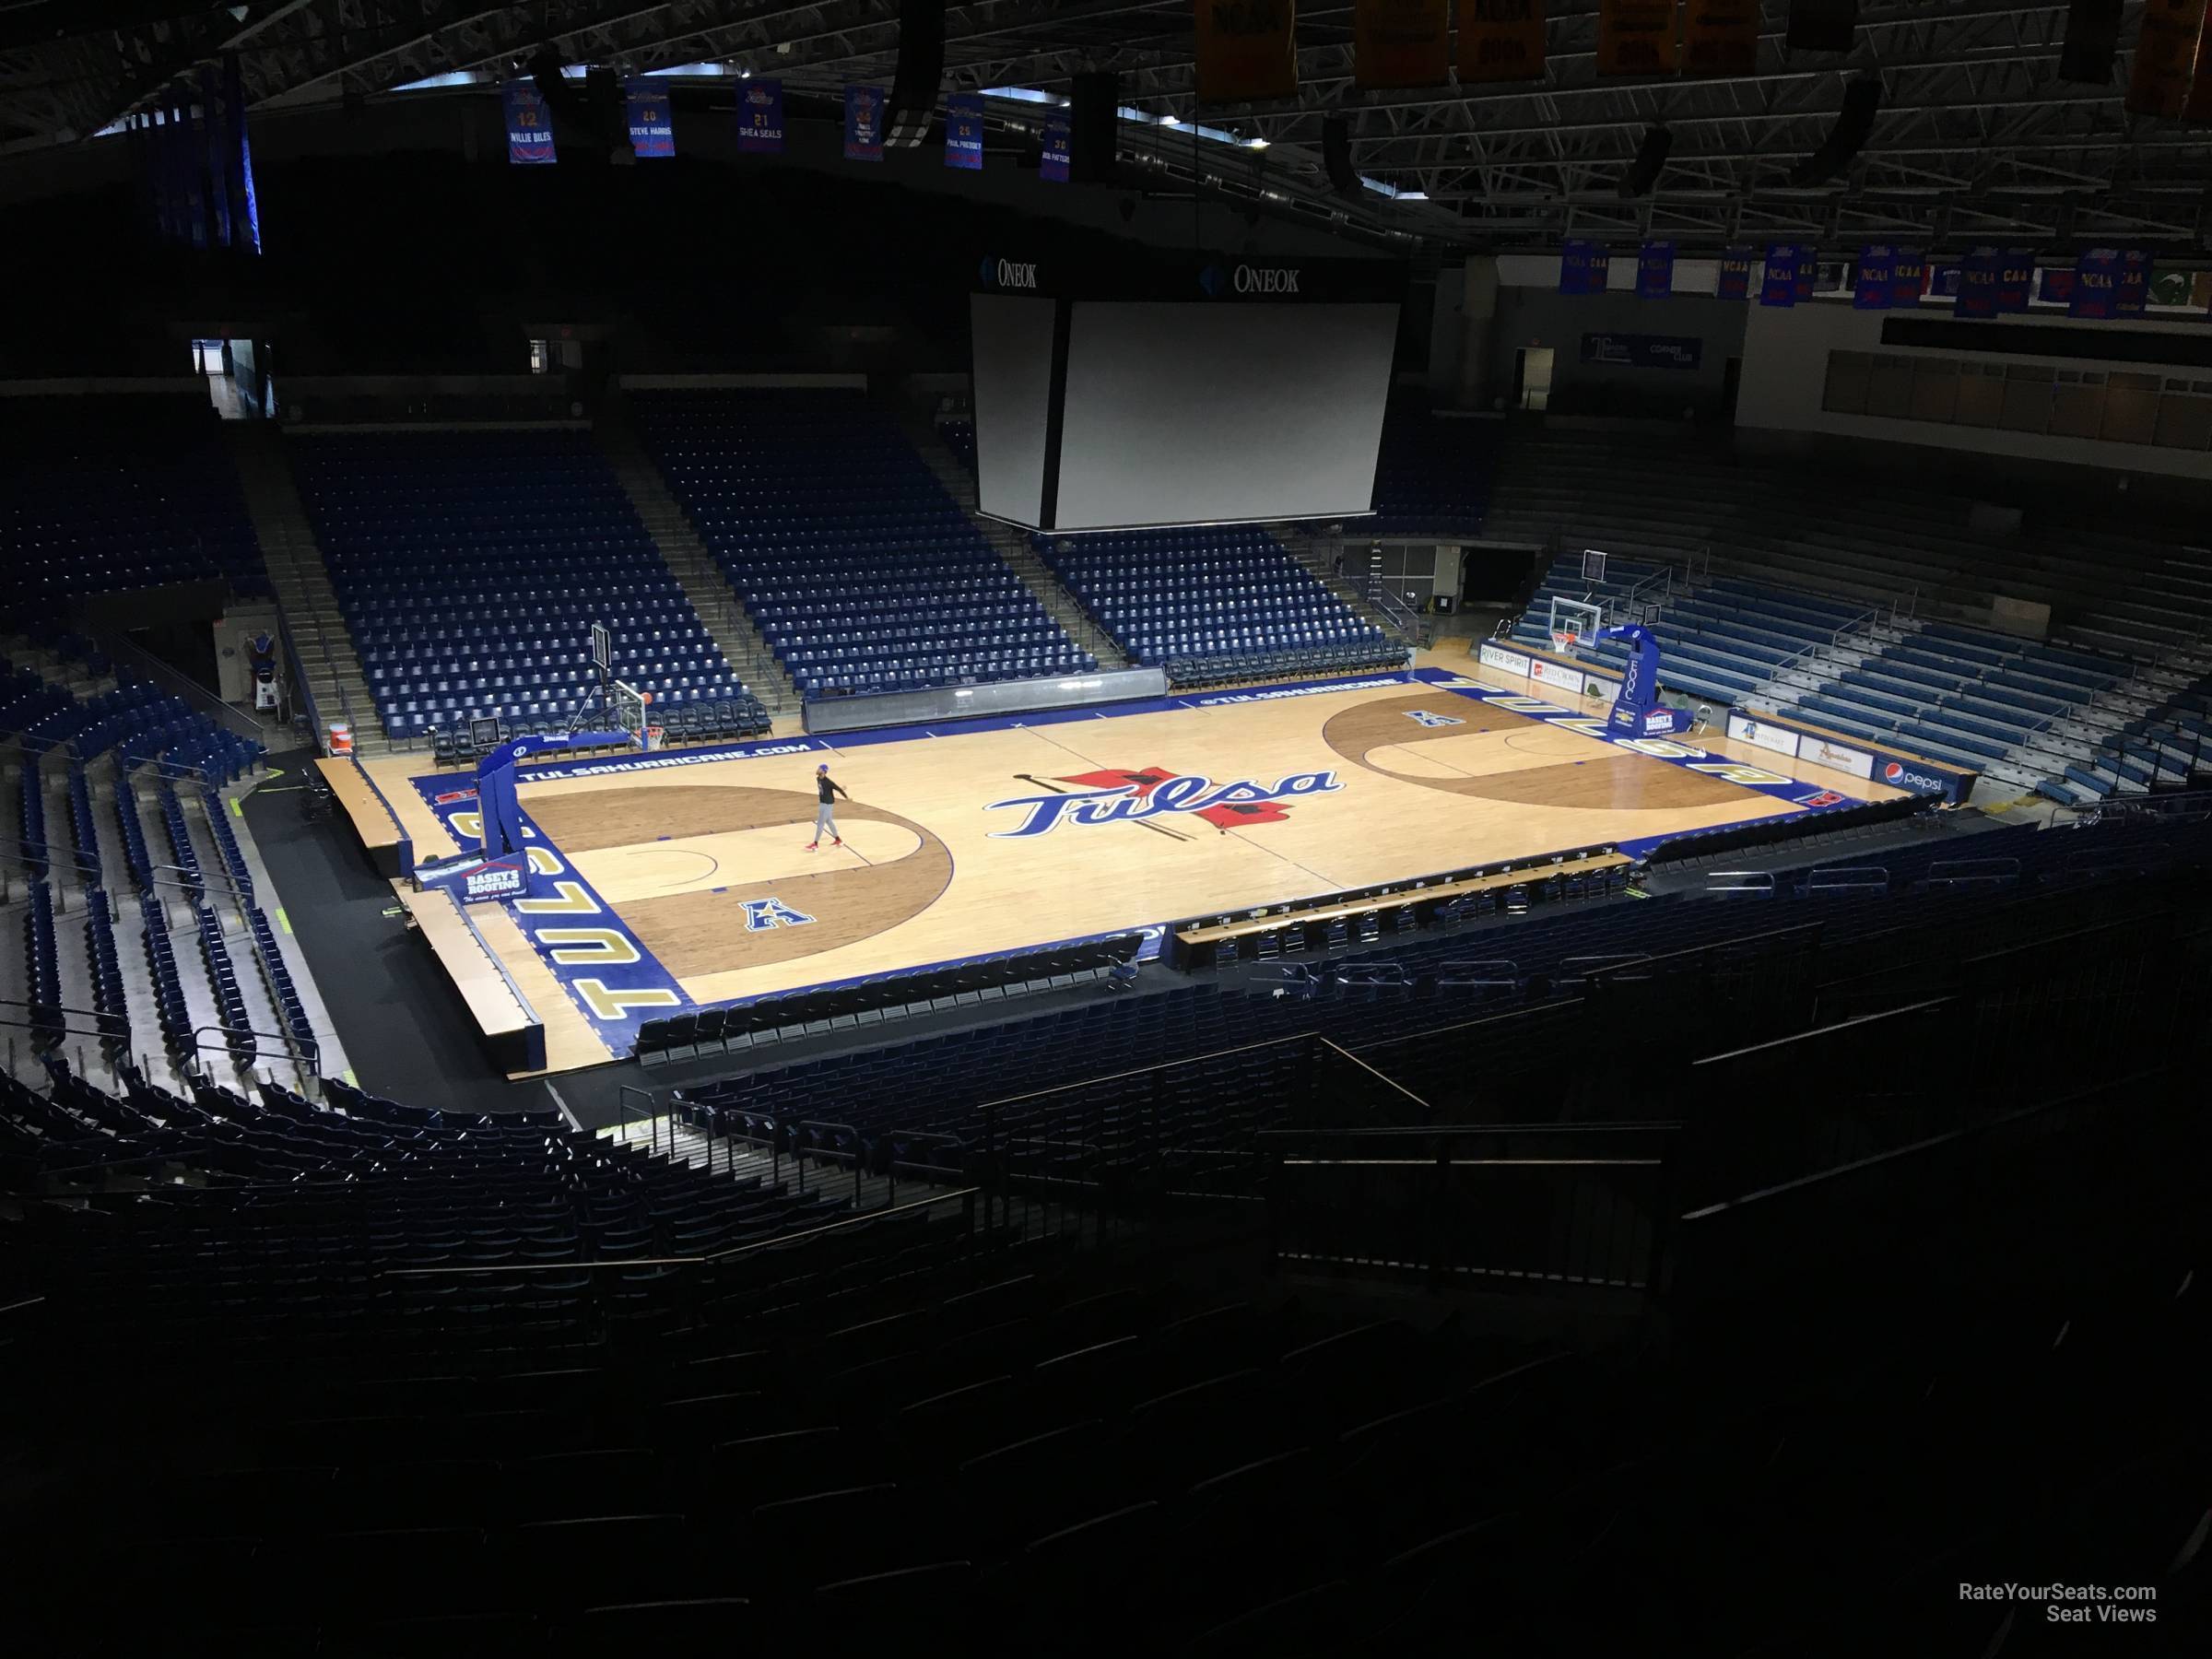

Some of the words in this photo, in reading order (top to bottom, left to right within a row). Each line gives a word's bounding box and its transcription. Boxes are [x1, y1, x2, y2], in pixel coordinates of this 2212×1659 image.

[516, 111, 537, 126] 12
[642, 111, 656, 122] 20
[755, 113, 768, 126] 21
[510, 132, 532, 143] WILLIE
[534, 131, 551, 142] BILES
[629, 127, 649, 135] STEVE
[739, 126, 759, 137] SHEA
[760, 128, 782, 139] SEALS
[998, 258, 1037, 288] ONEOK
[1234, 265, 1300, 293] ONEOK
[1481, 647, 1504, 662] RIVER
[1506, 653, 1528, 669] SPIRIT
[519, 743, 811, 782] TULSAHURRICANE.COM
[1904, 772, 1943, 791] pepsi
[982, 770, 1347, 839] Tulsa
[466, 869, 519, 886] BASEY'S
[467, 878, 521, 895] ROOFING
